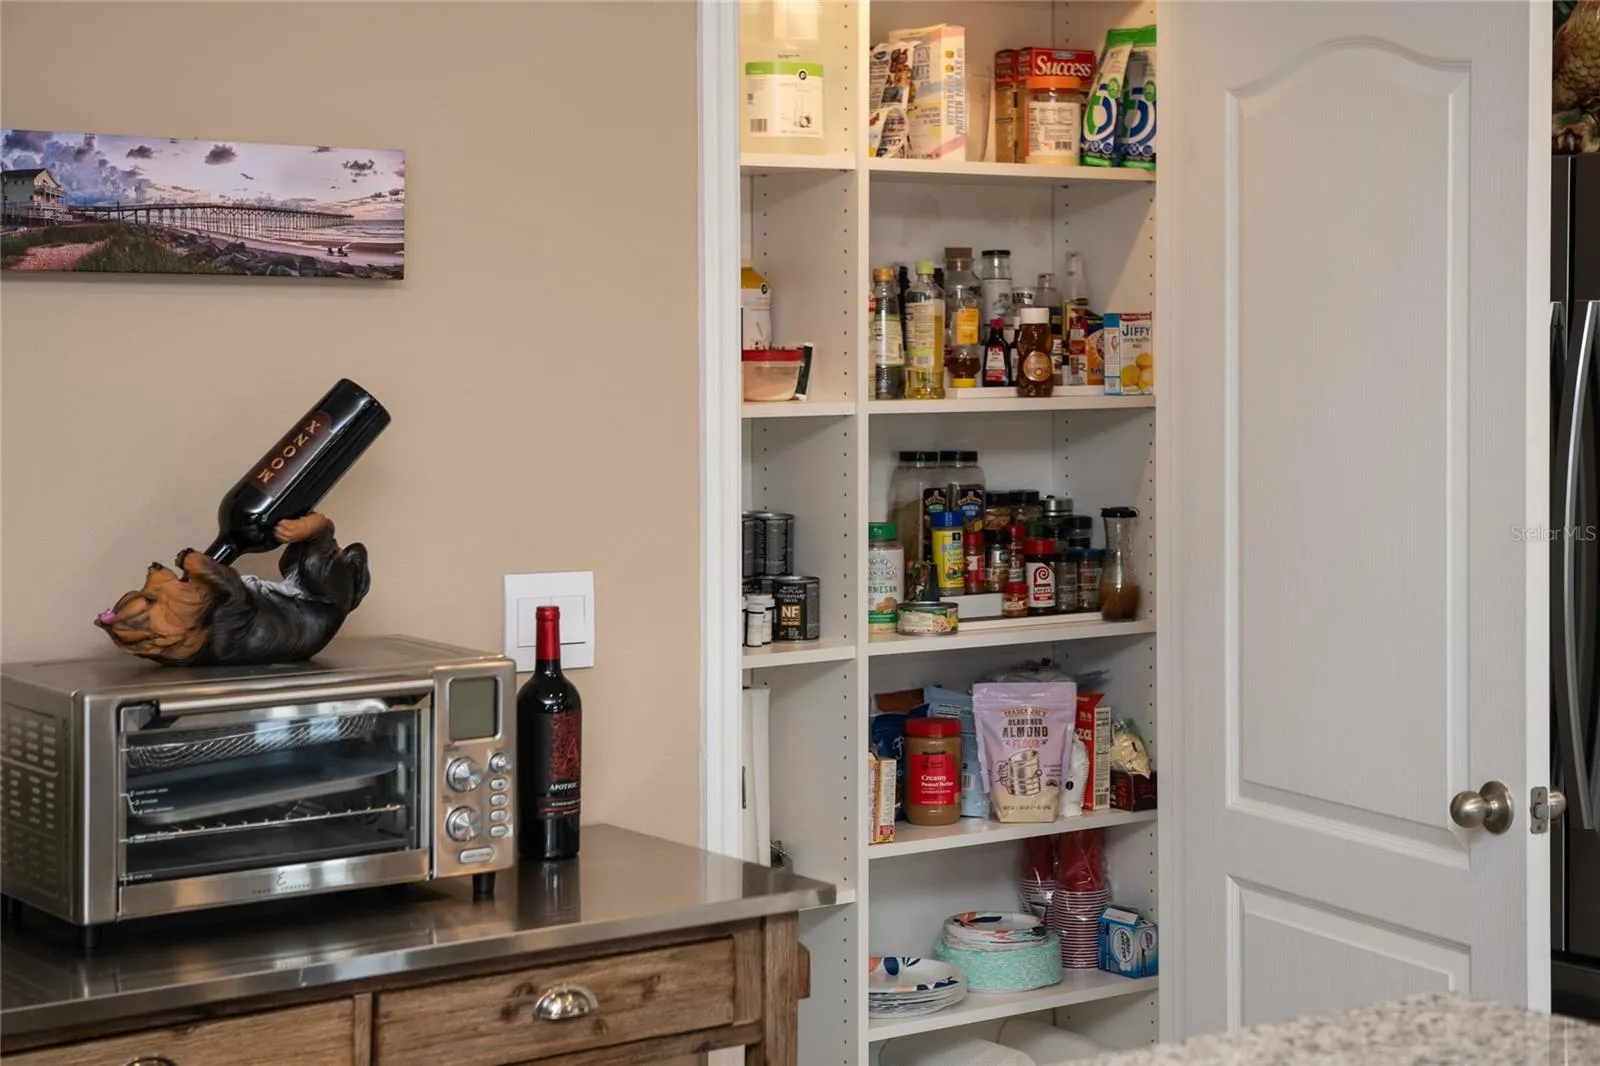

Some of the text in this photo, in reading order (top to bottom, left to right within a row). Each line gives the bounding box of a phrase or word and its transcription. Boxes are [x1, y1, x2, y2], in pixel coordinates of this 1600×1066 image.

[1034, 56, 1092, 77] Success
[1121, 324, 1151, 337] JIFFY
[257, 419, 321, 484] MOONX
[781, 606, 800, 618] NF
[1002, 726, 1049, 738] ALMOND
